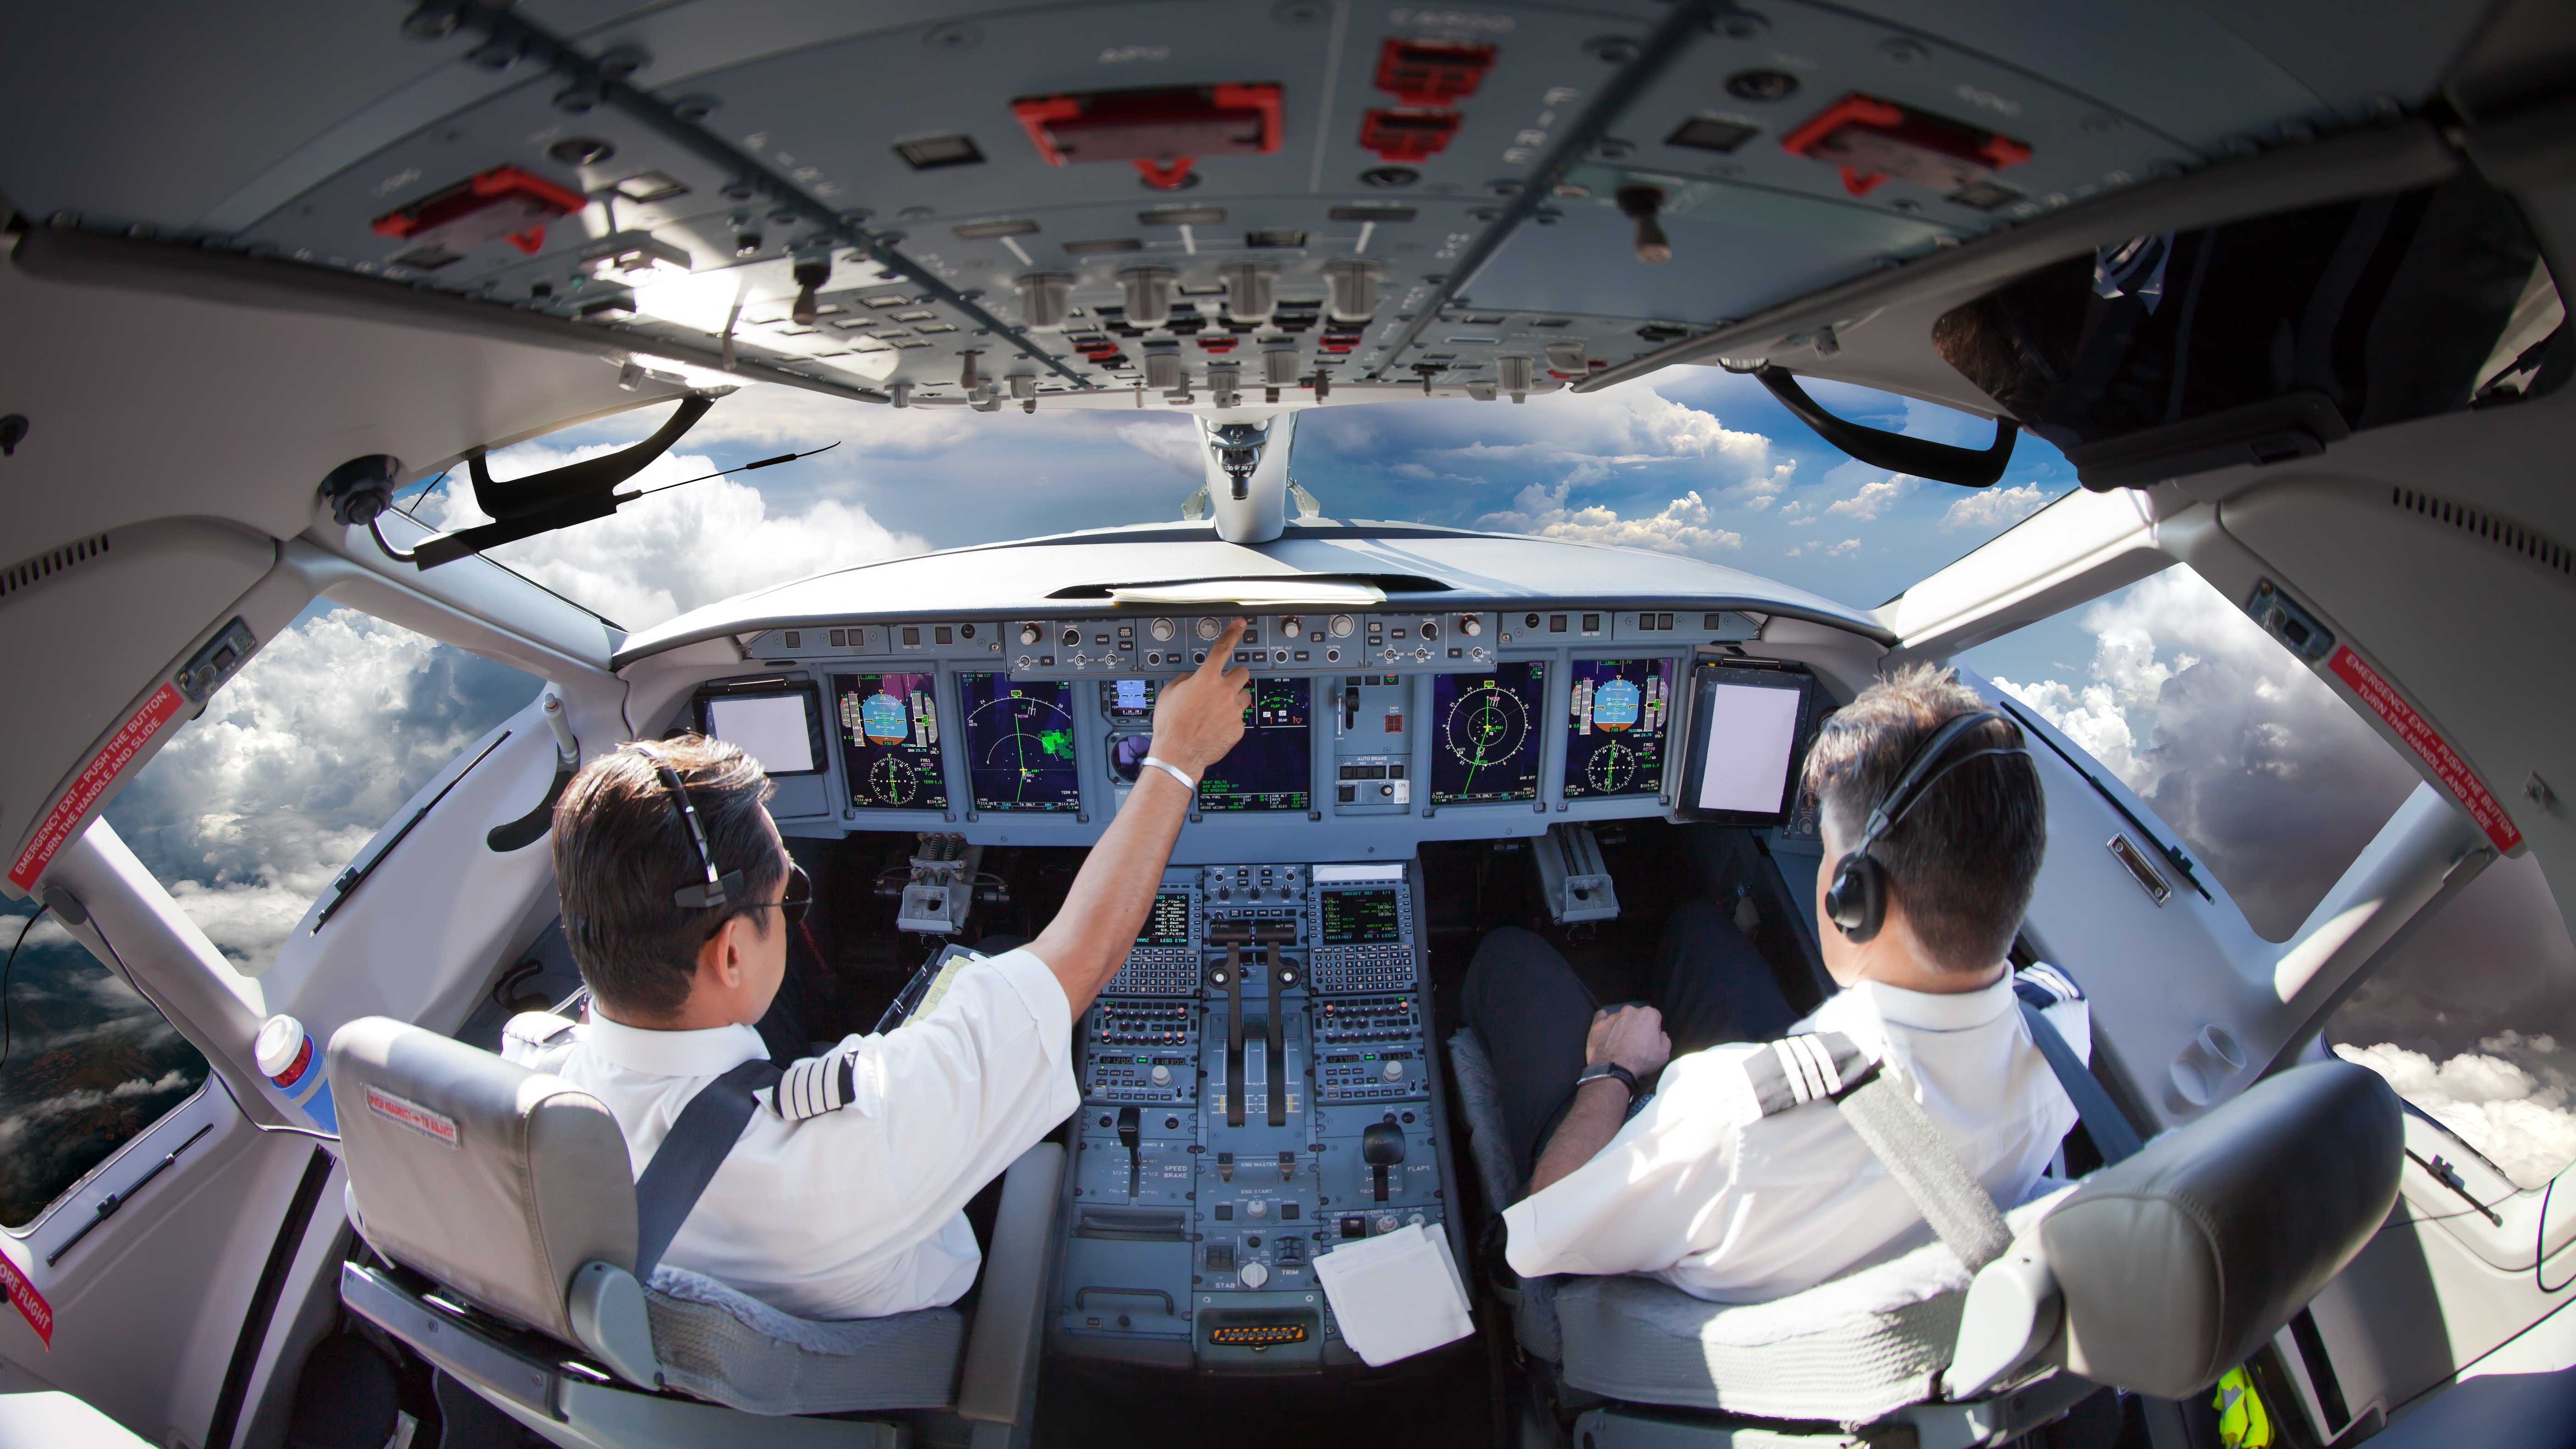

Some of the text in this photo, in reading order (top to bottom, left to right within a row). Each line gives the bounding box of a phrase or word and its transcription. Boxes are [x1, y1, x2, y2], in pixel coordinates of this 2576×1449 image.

[15, 811, 61, 875] EMERGENCY
[59, 788, 79, 813] EXIT
[83, 751, 110, 783] PUSH
[108, 731, 130, 754] THE
[128, 690, 170, 734] BUTTON,
[39, 716, 161, 862] TURN THE HANDLE AND SLIDE
[2346, 653, 2410, 716] EMERGENCY
[2409, 713, 2432, 738] EXIT
[2437, 744, 2465, 776] PUSH
[2464, 772, 2484, 797] THE
[2359, 682, 2493, 830] TURN THE HANDLE AND SLIDE
[0, 1264, 50, 1329] ORE FLIGHT
